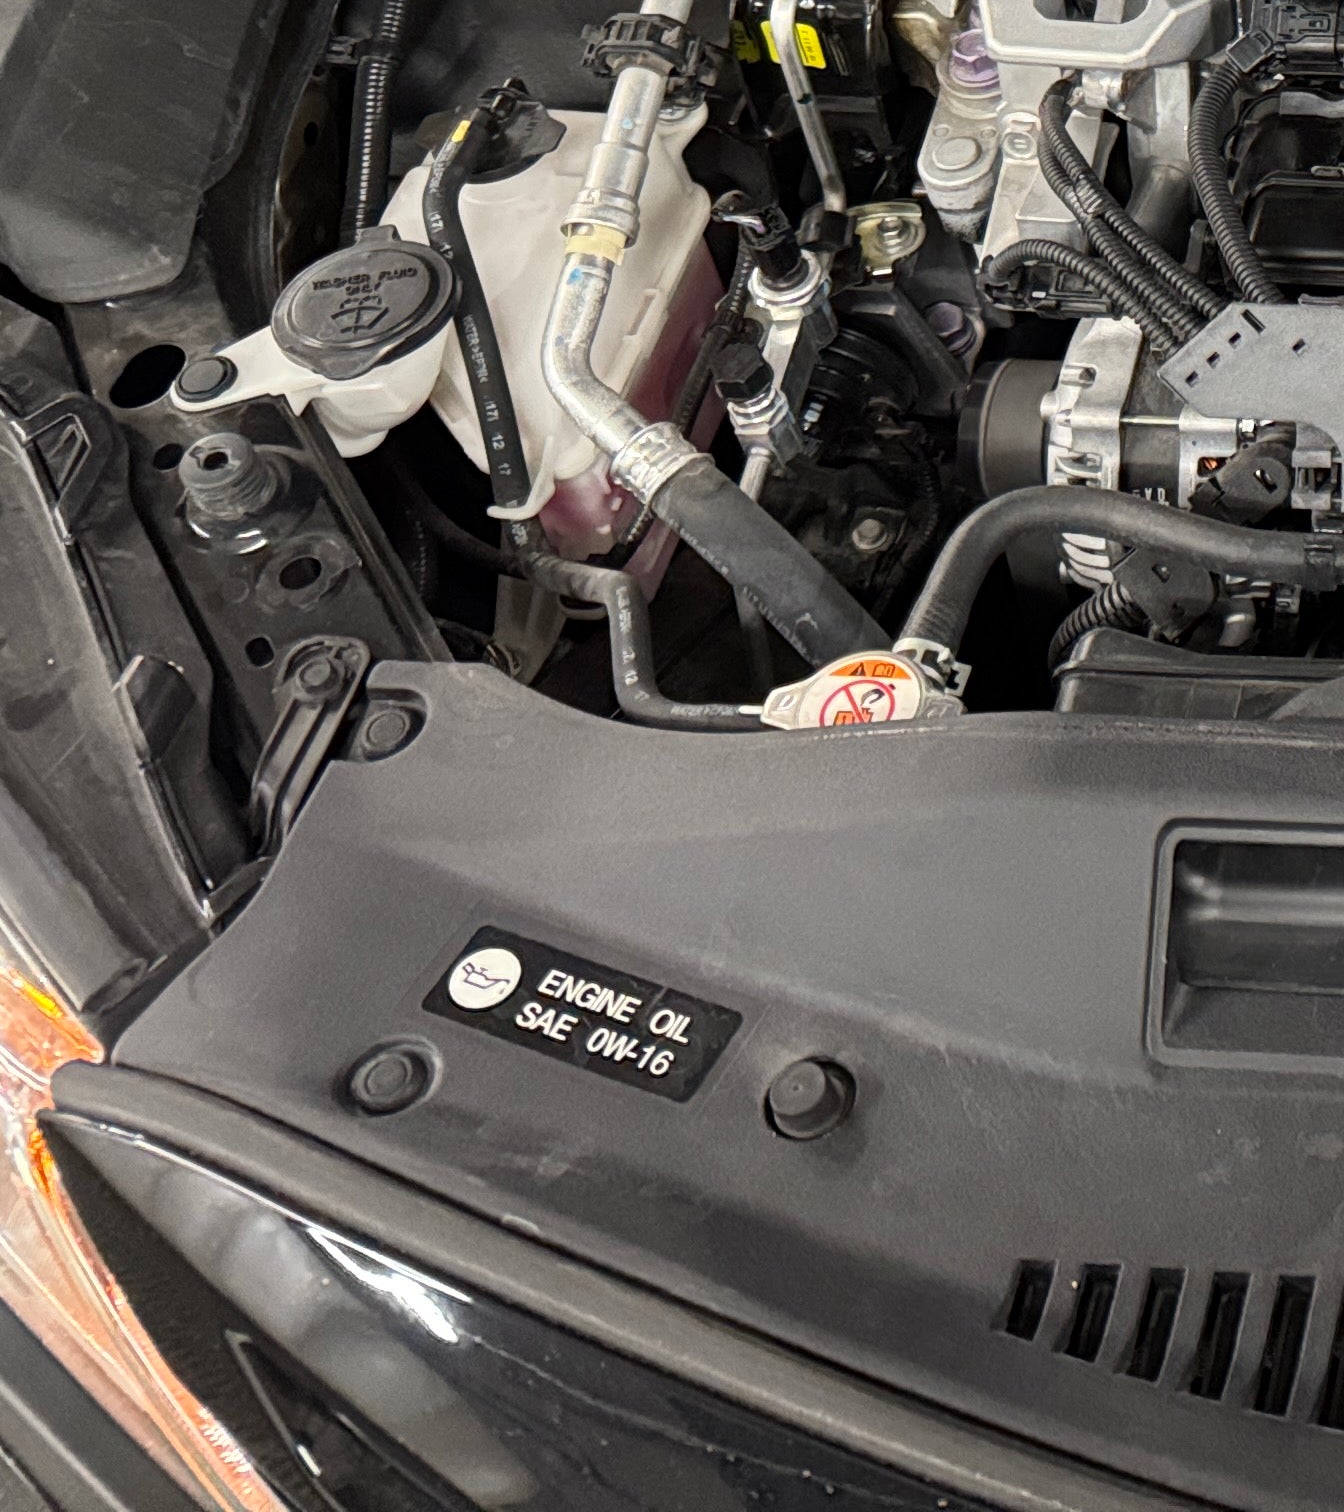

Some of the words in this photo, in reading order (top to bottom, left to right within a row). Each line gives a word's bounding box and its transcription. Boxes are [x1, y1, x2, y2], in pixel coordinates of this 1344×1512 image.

[490, 436, 505, 451] 12
[497, 463, 512, 478] 17
[537, 968, 643, 1024] ENGINE
[649, 1009, 695, 1046] OIL
[515, 1001, 579, 1042] SAE
[586, 1026, 675, 1078] 0W-16
